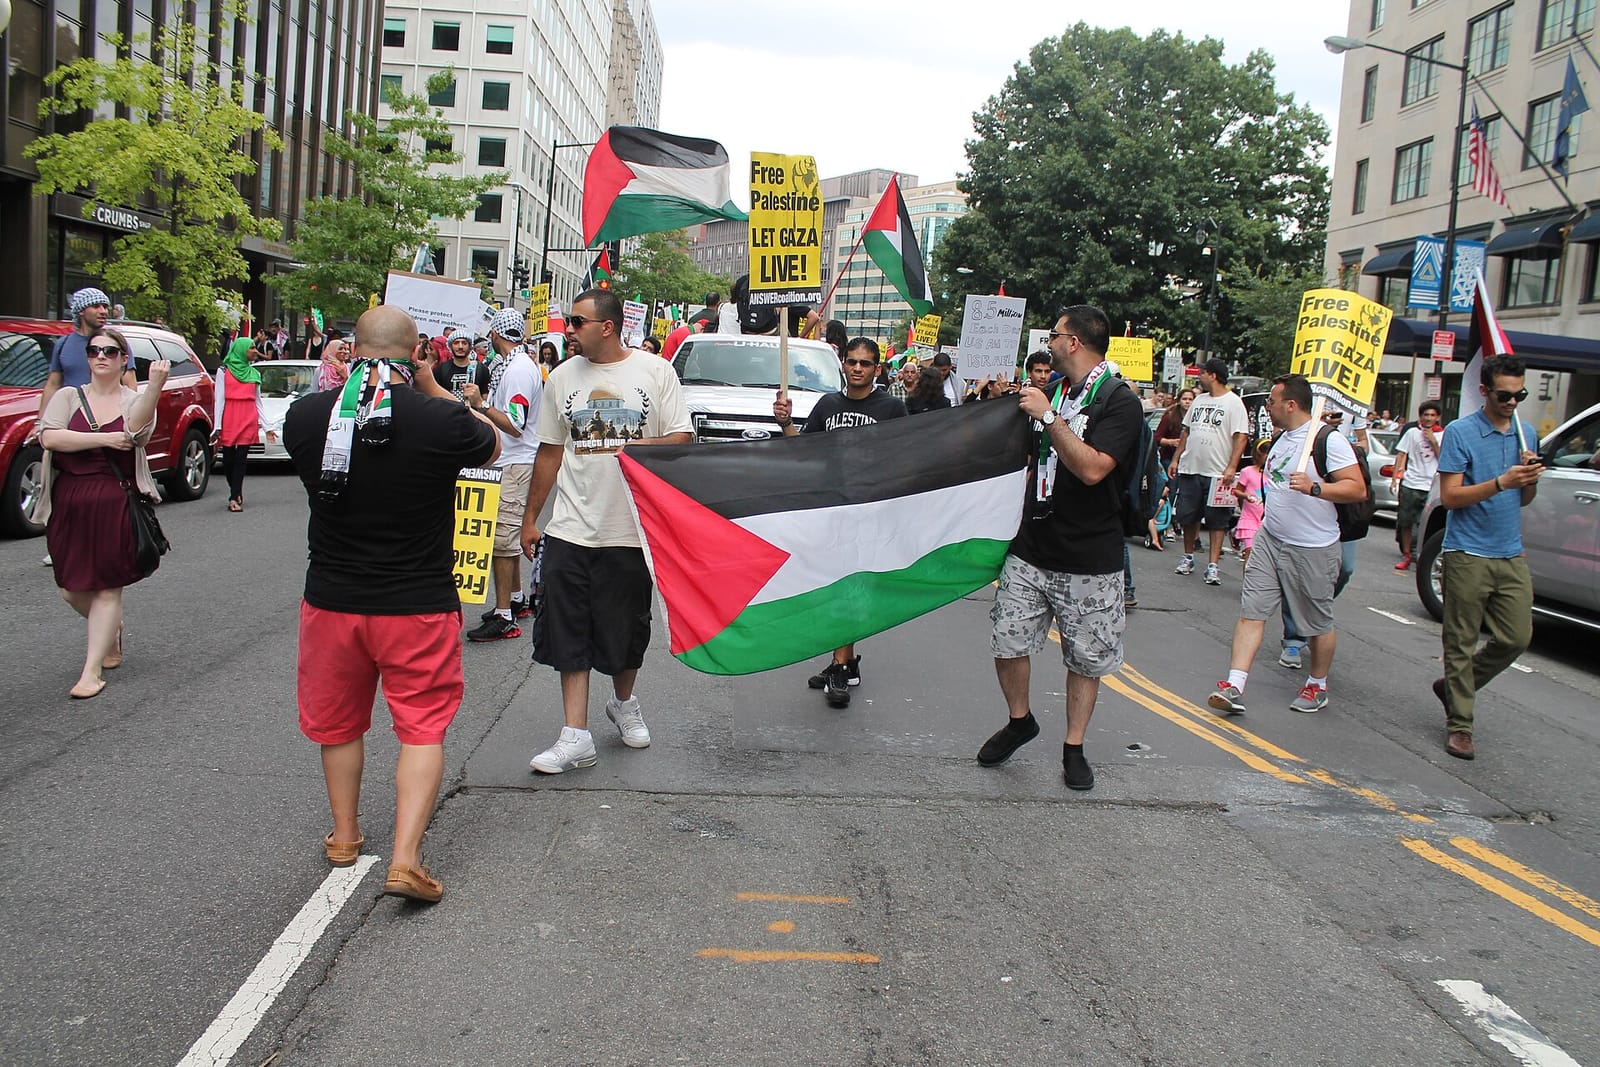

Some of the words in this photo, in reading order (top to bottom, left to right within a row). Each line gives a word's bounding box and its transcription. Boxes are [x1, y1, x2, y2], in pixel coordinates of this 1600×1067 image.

[751, 161, 784, 184] Free
[751, 190, 820, 212] Palestine
[97, 207, 139, 230] CRUMBS
[752, 228, 775, 247] LET
[780, 228, 818, 247] GAZA
[760, 254, 807, 283] LIVE!
[749, 291, 823, 305] ANSWERcoalition.org
[1302, 296, 1349, 312] Free
[409, 306, 429, 314] Please
[430, 310, 453, 318] protect
[1298, 314, 1380, 347] Palestine
[968, 354, 1013, 368] ISRAEL
[1295, 339, 1325, 358] LET
[1331, 341, 1375, 374] GAZA
[1300, 358, 1361, 393] LIVE!
[604, 437, 625, 448] your
[460, 518, 492, 538] LET
